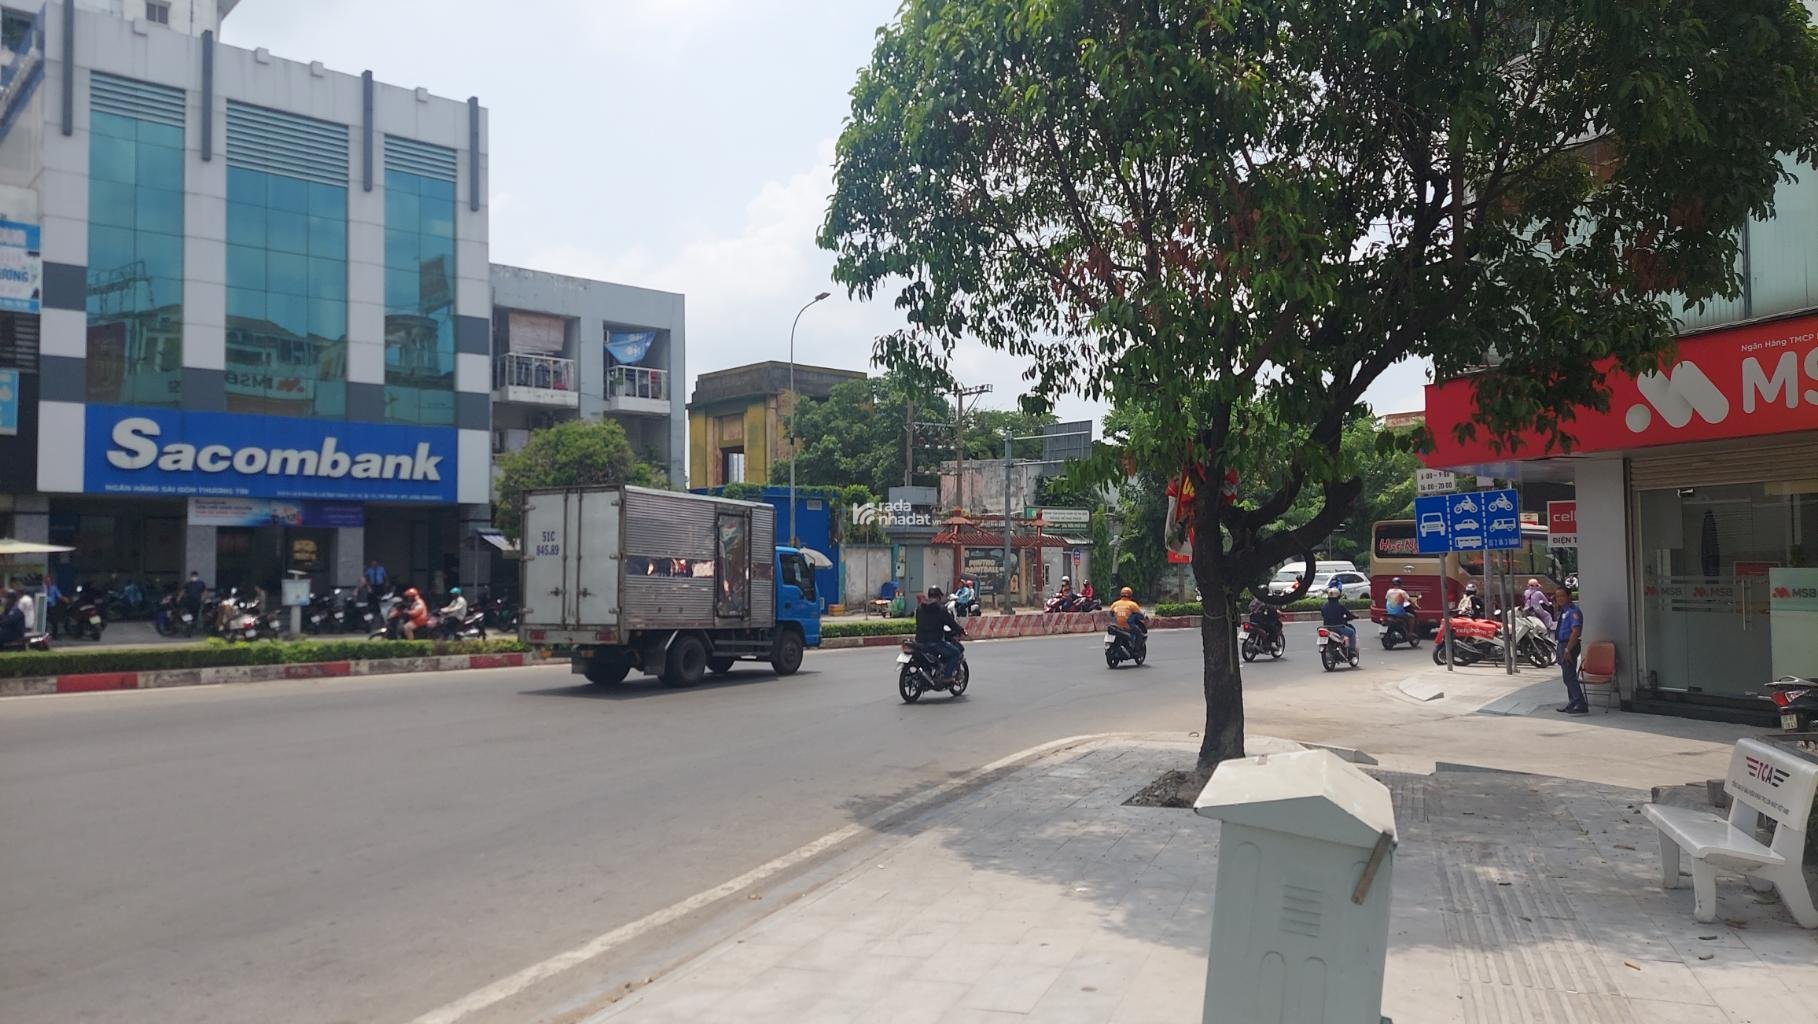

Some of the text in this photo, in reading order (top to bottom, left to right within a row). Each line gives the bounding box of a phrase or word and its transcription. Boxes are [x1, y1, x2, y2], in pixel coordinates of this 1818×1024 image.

[1741, 342, 1763, 351] Ngân
[1789, 333, 1814, 343] TMCP
[106, 416, 443, 481] Sacombank
[542, 530, 556, 542] 51C
[1792, 587, 1817, 598] MSB
